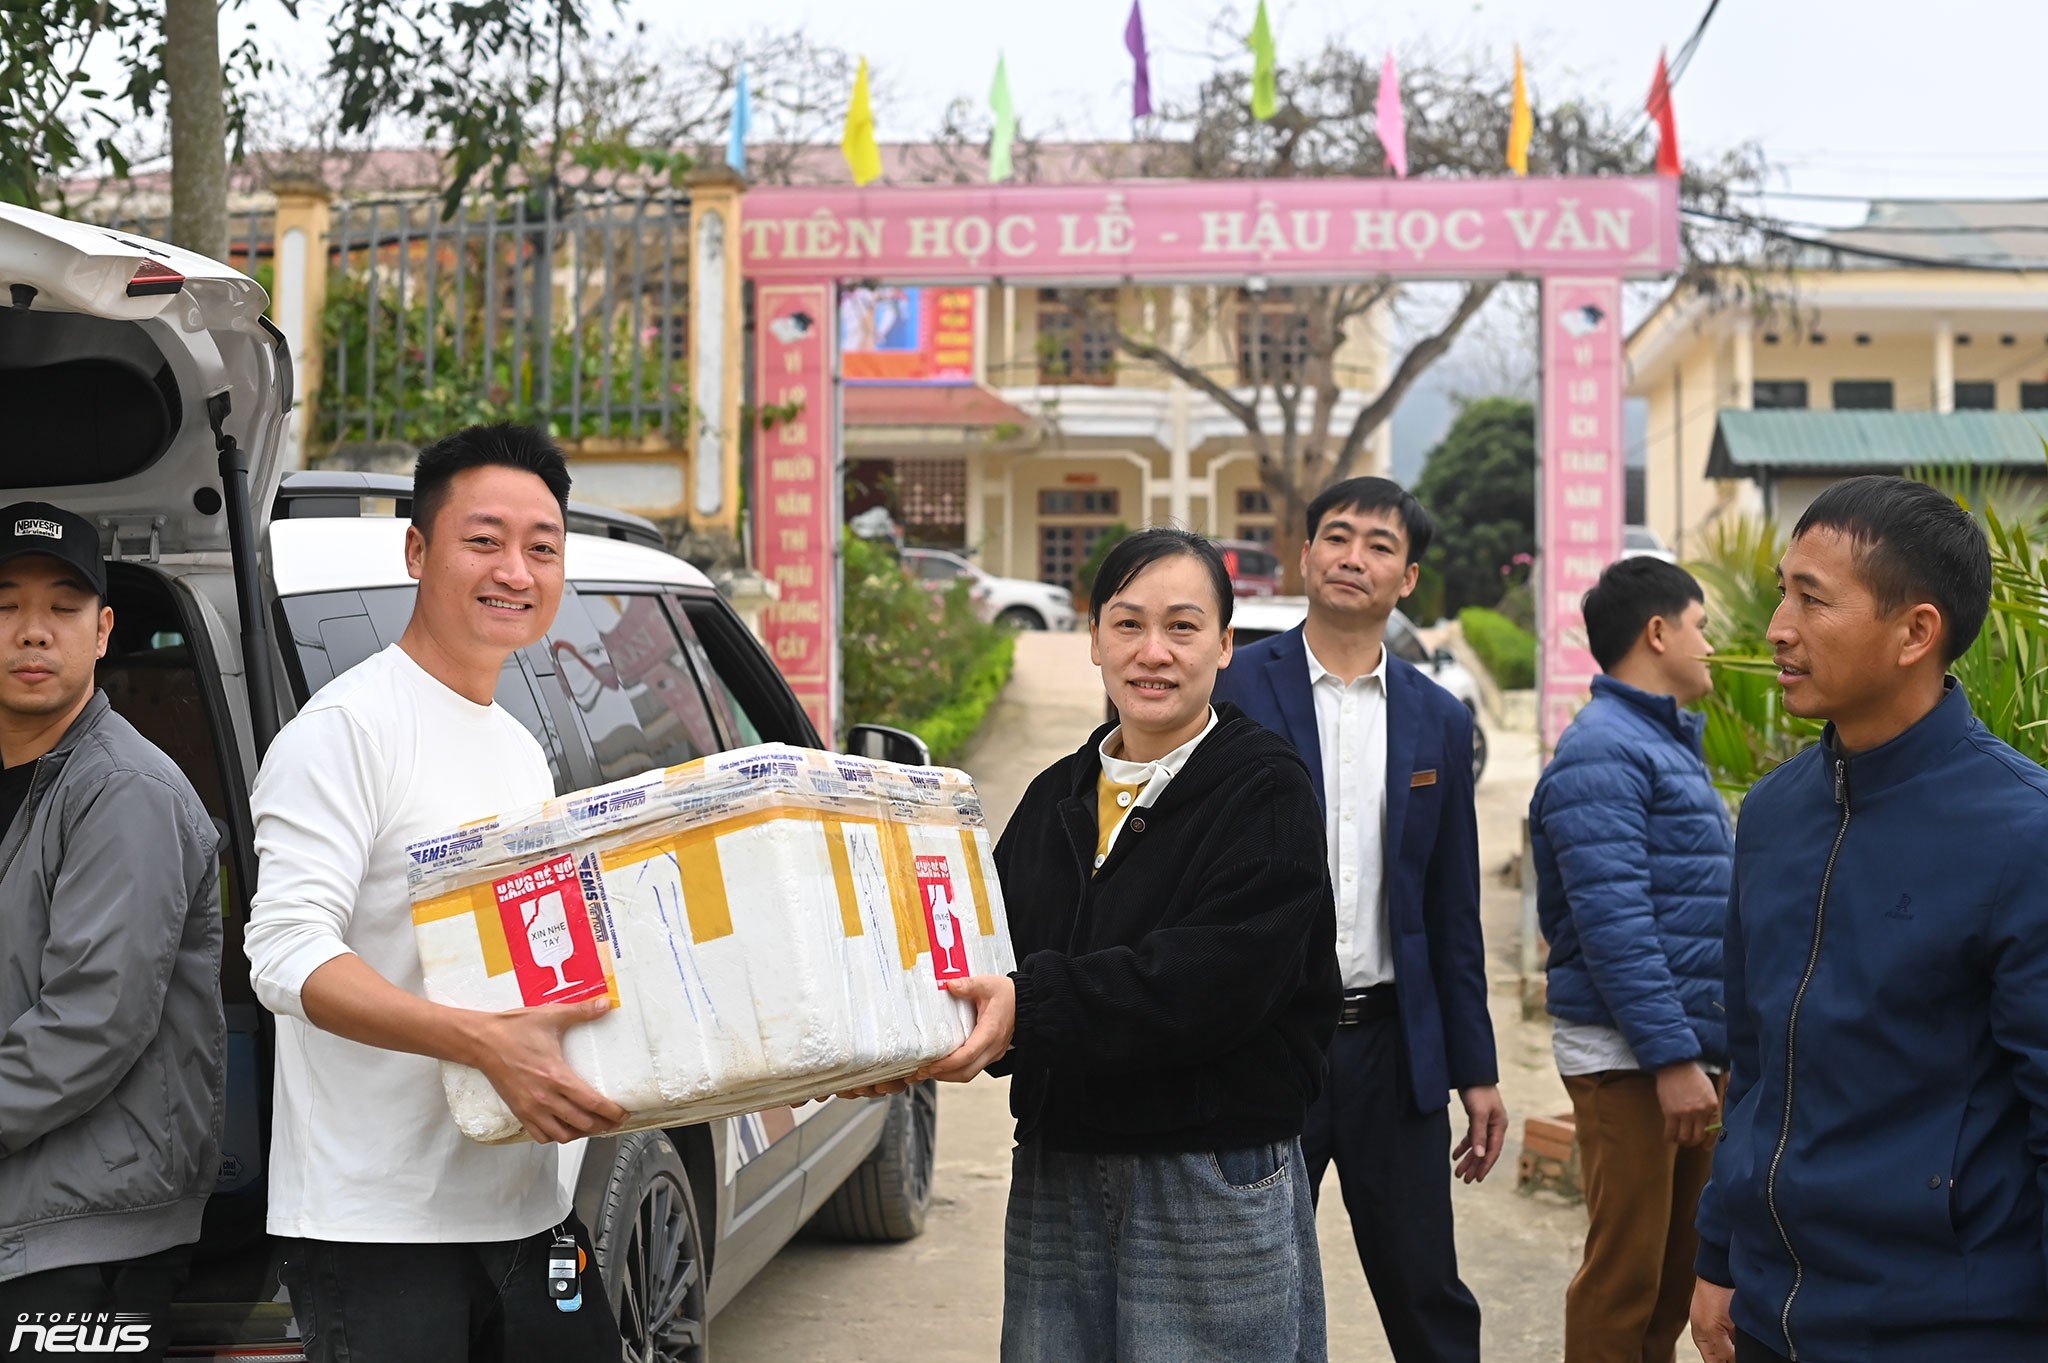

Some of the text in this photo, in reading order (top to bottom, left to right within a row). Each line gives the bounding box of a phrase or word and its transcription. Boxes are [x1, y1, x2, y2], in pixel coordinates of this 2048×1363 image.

[742, 207, 886, 259] TIÊN
[907, 214, 1037, 267] HỌC
[1057, 192, 1136, 256] LỄ
[1200, 199, 1331, 260] HẬU
[1351, 208, 1486, 260] HỌC
[1504, 197, 1635, 250] VĂN
[749, 761, 778, 778] EMS
[578, 797, 646, 819] EMS VIETNAM
[419, 844, 449, 863] EMS
[448, 840, 483, 855] VIETNAM
[578, 869, 605, 943] EMS VIETNAM
[605, 914, 614, 928] STOCK
[531, 930, 546, 941] XIN
[543, 936, 560, 948] TAY
[609, 929, 622, 958] CORPORATION
